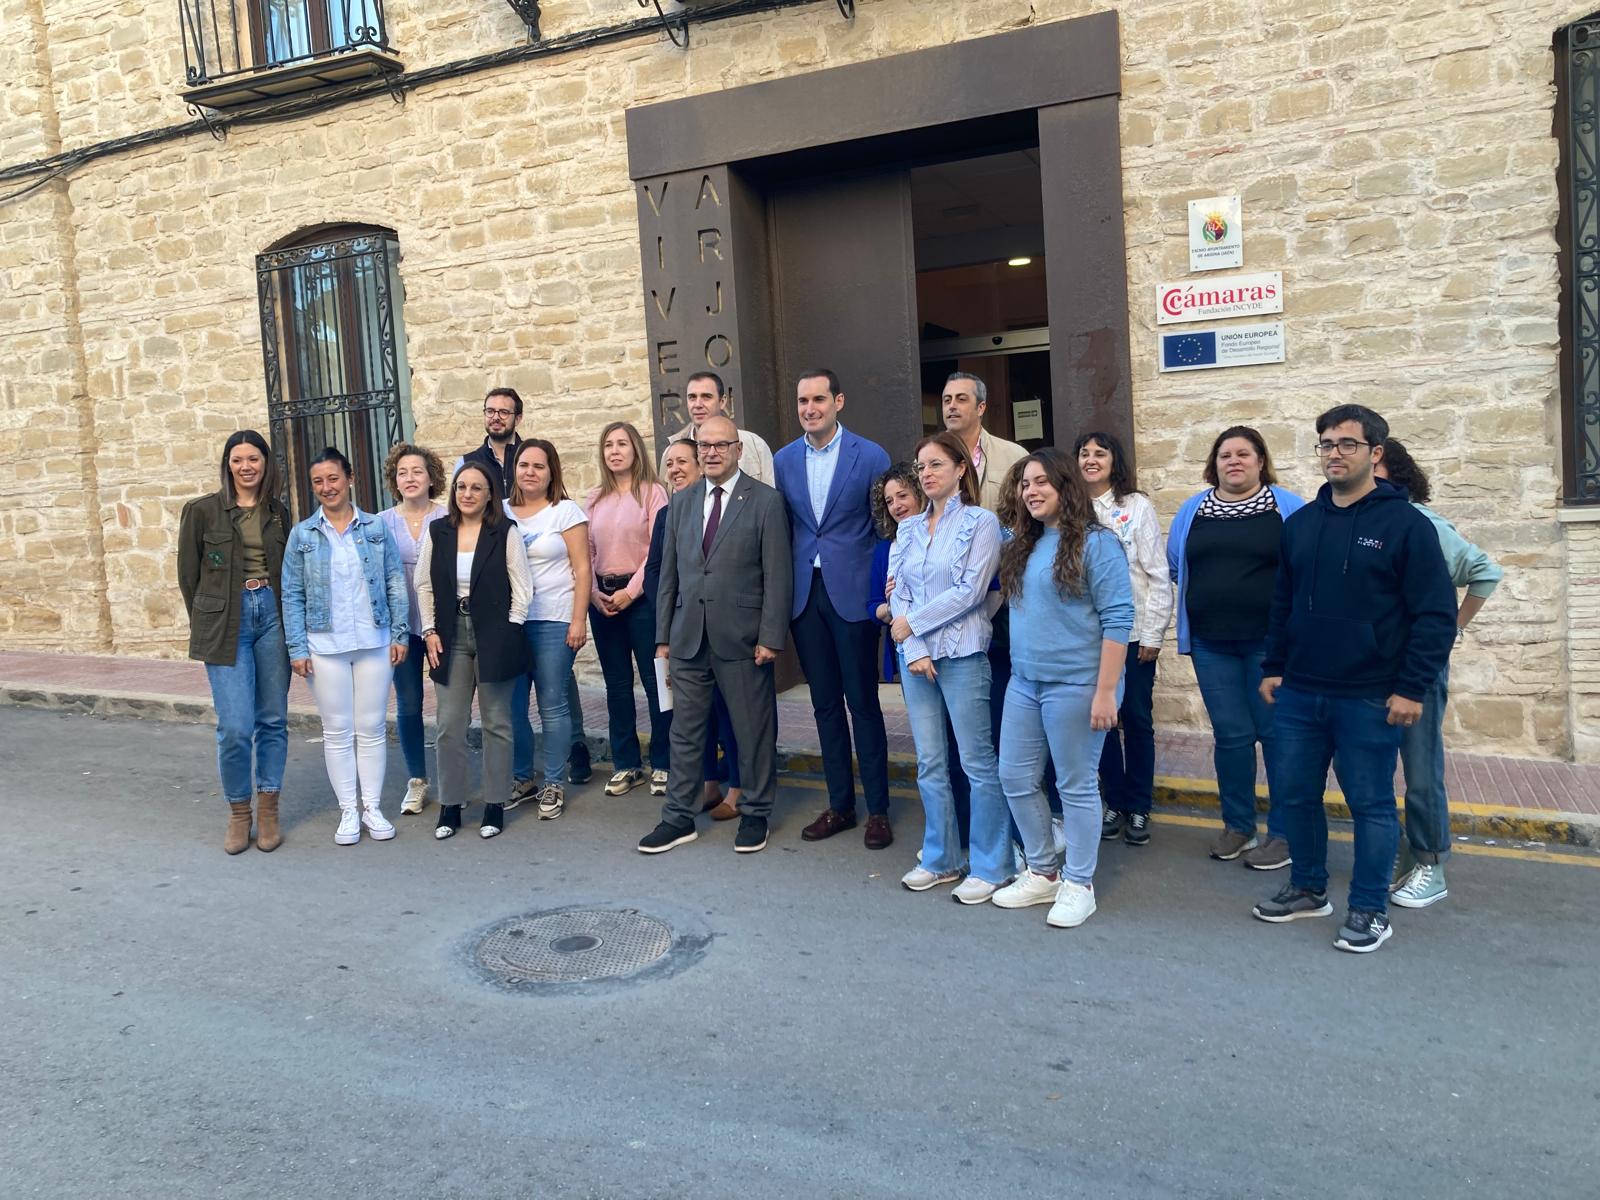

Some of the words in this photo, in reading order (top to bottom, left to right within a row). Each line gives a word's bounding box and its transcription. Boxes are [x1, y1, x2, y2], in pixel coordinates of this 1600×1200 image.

[1198, 304, 1232, 315] Fundación
[1232, 302, 1263, 312] INCYDE
[1221, 332, 1243, 341] UNIÓN
[1244, 330, 1278, 339] EUROPEA
